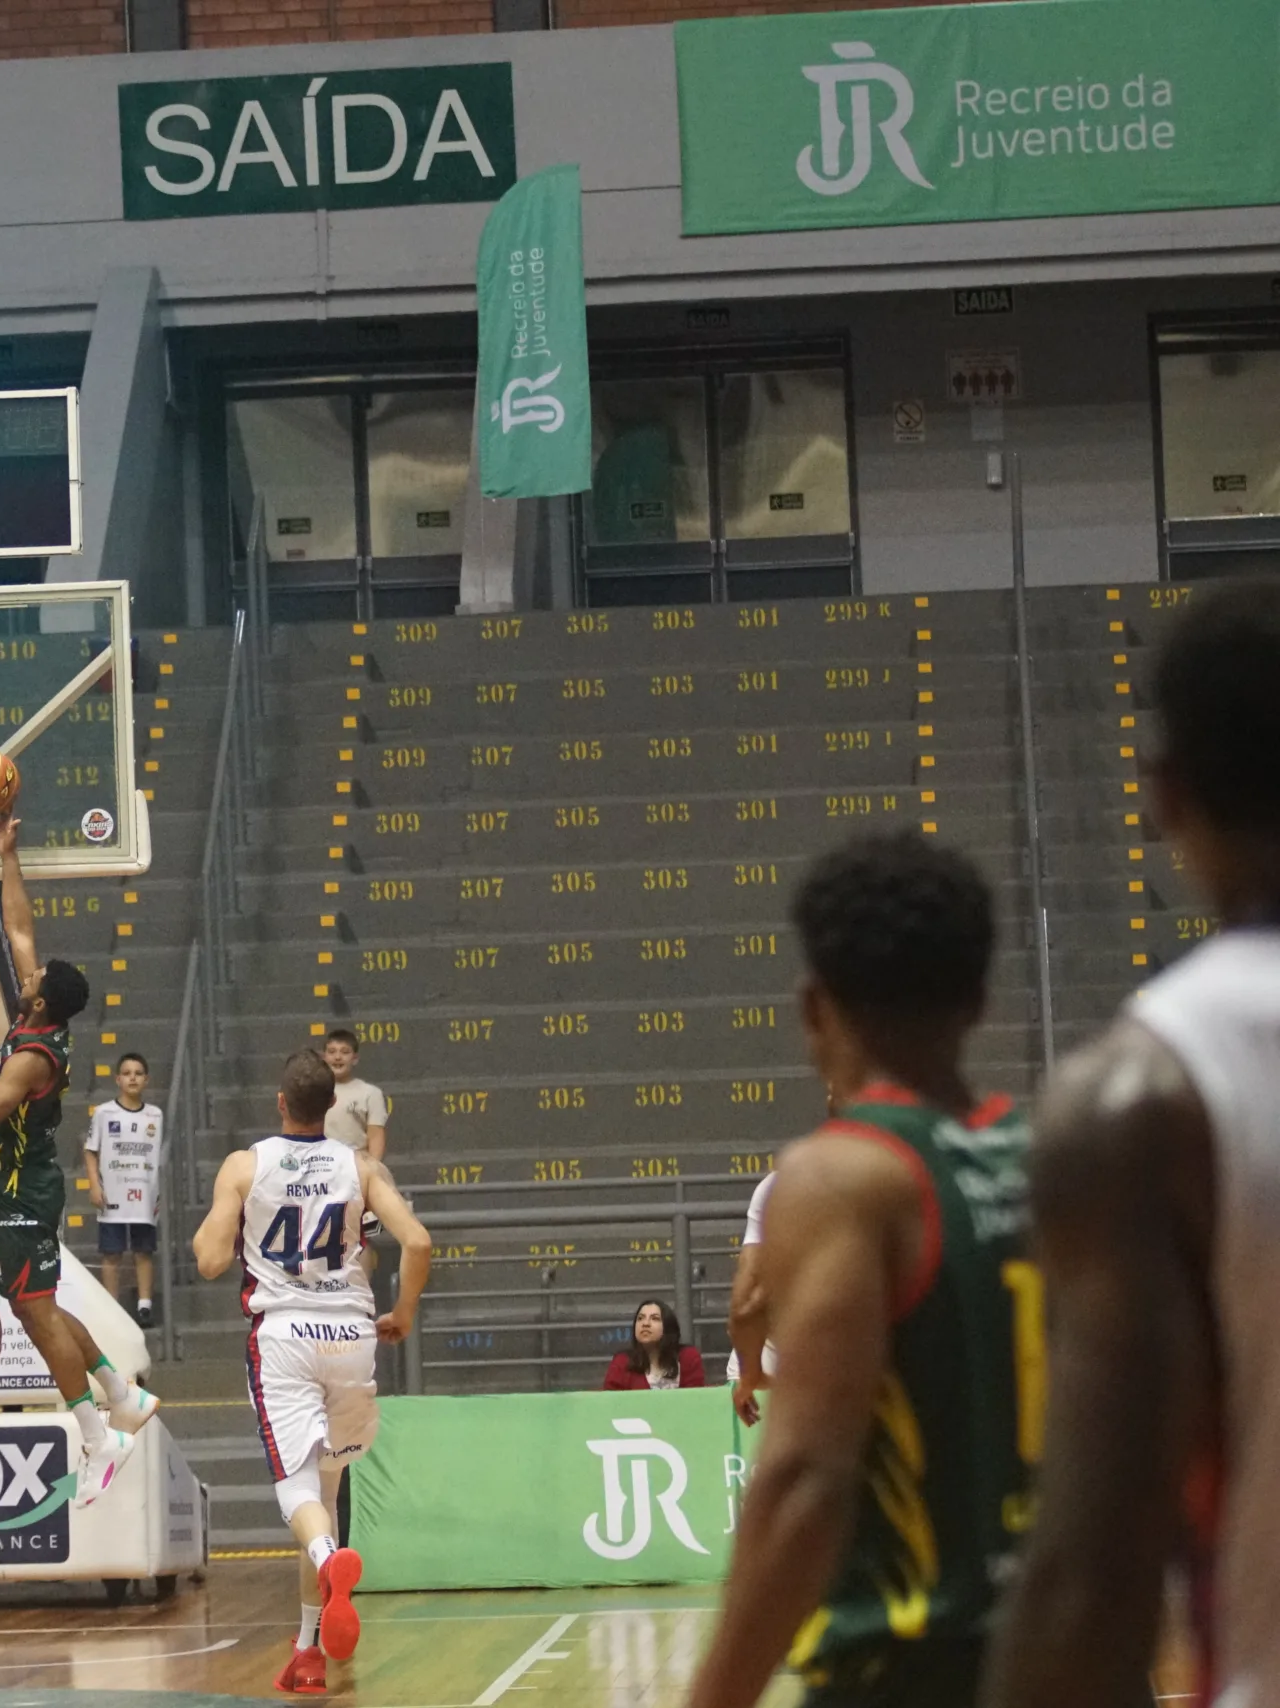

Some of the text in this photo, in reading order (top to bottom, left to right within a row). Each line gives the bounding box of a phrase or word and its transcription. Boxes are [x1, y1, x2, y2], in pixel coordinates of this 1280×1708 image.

[954, 73, 1173, 117] Recreio da
[143, 77, 496, 196] SAÍDA
[951, 114, 1176, 168] Juventude
[508, 250, 527, 358] Recreio da
[528, 247, 551, 356] Juventude
[653, 610, 695, 630] 303
[738, 608, 778, 628] 301
[824, 602, 870, 623] 299
[397, 624, 438, 641] 309
[567, 614, 609, 633] 305
[738, 671, 778, 691] 301
[825, 669, 869, 689] 299
[389, 688, 432, 706] 309
[477, 683, 517, 703] 307
[561, 740, 603, 760] 305
[648, 738, 692, 757] 303
[737, 735, 777, 756] 301
[825, 731, 870, 752] 299
[381, 747, 425, 768] 309
[473, 745, 512, 765] 307
[557, 807, 600, 826] 305
[738, 800, 777, 820] 301
[825, 796, 871, 818] 299
[377, 813, 420, 833] 309
[466, 810, 508, 831] 307
[552, 872, 596, 893] 305
[643, 869, 688, 889] 303
[735, 865, 777, 884] 301
[369, 880, 414, 901] 309
[461, 877, 503, 898] 307
[34, 896, 75, 917] 312
[548, 943, 593, 963] 305
[640, 938, 687, 960] 303
[734, 935, 776, 955] 301
[362, 951, 408, 969] 309
[455, 947, 499, 968] 307
[543, 1014, 589, 1034] 305
[638, 1011, 685, 1033] 303
[733, 1008, 775, 1027] 301
[355, 1022, 401, 1041] 309
[449, 1018, 494, 1041] 307
[444, 1091, 488, 1113] 307
[538, 1088, 585, 1108] 305
[635, 1085, 682, 1105] 303
[731, 1082, 775, 1102] 301
[437, 1165, 483, 1184] 307
[534, 1159, 582, 1181] 305
[632, 1157, 679, 1177] 303
[730, 1155, 774, 1174] 301
[286, 1182, 328, 1197] RENAN
[259, 1201, 349, 1276] 44
[290, 1322, 360, 1341] NATIVAS
